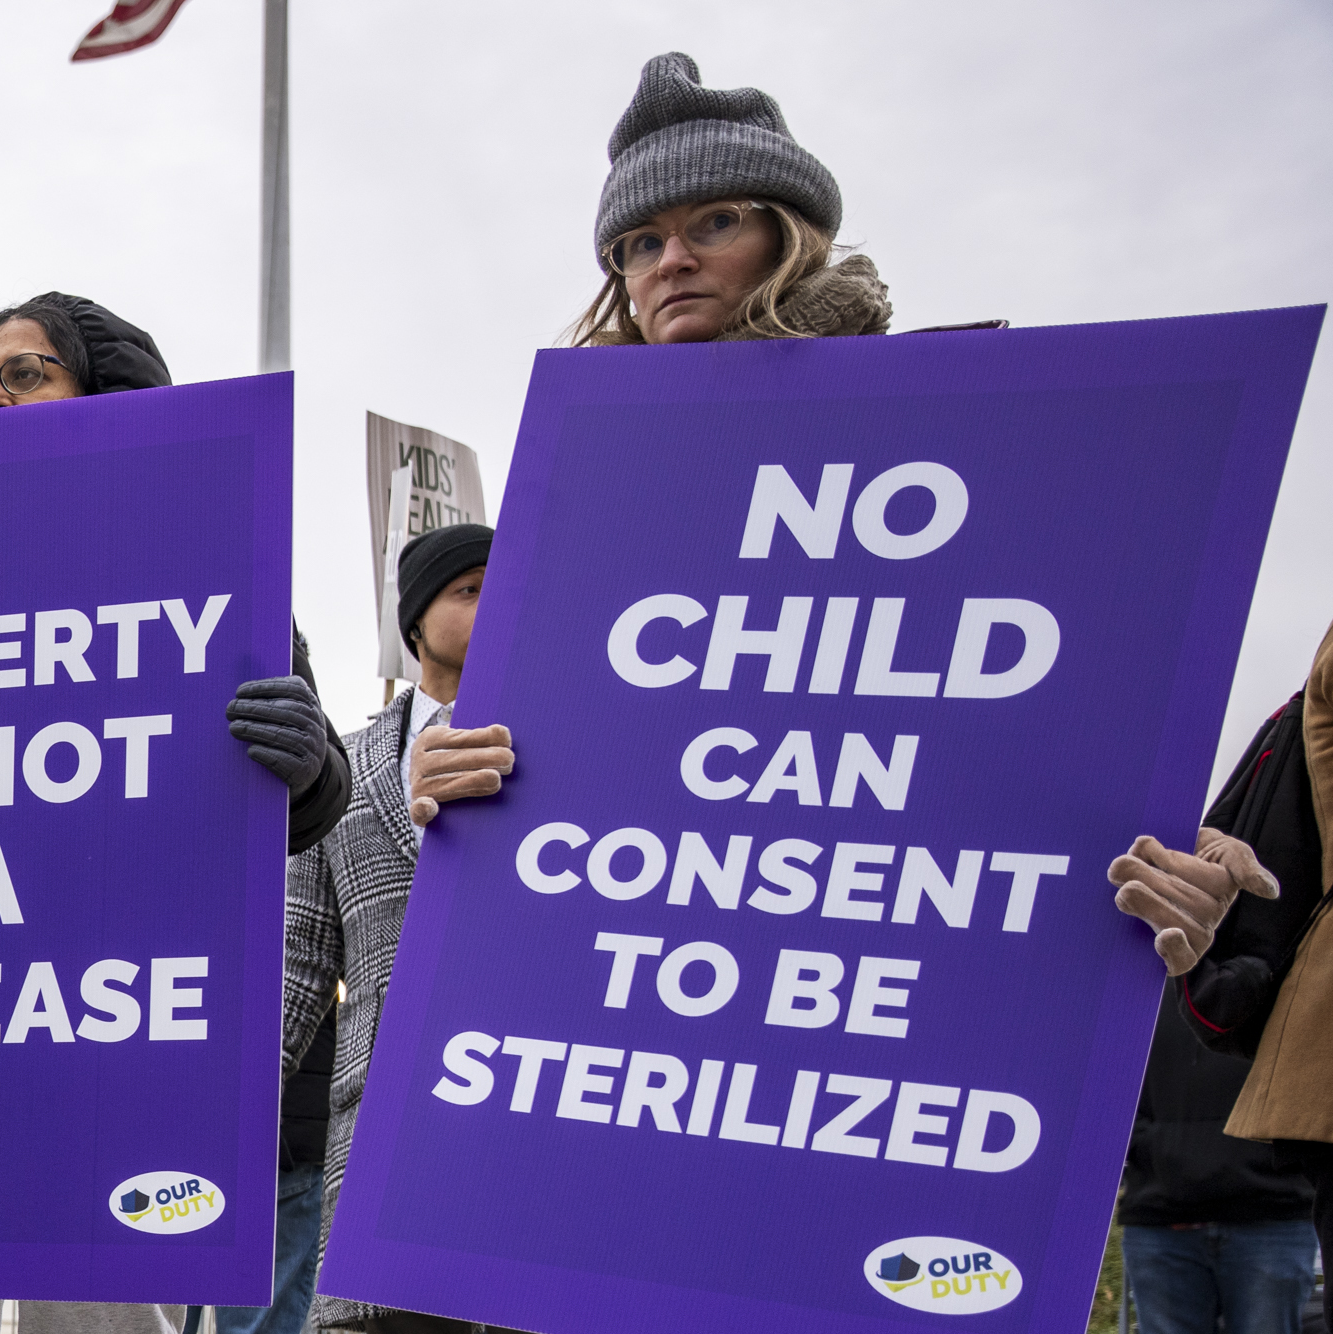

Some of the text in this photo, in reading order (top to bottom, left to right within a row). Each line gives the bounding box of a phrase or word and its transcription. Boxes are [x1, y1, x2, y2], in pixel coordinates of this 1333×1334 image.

[740, 461, 968, 560] NO
[607, 594, 1060, 699] CHILD
[680, 726, 920, 811] CAN
[515, 822, 1069, 934] CONSENT
[594, 932, 920, 1040] TO BE
[432, 1030, 1041, 1173] STERILIZED
[155, 1178, 203, 1205] OUR
[161, 1190, 217, 1223] DUTY
[928, 1251, 994, 1278] OUR
[931, 1269, 1012, 1299] DUTY
